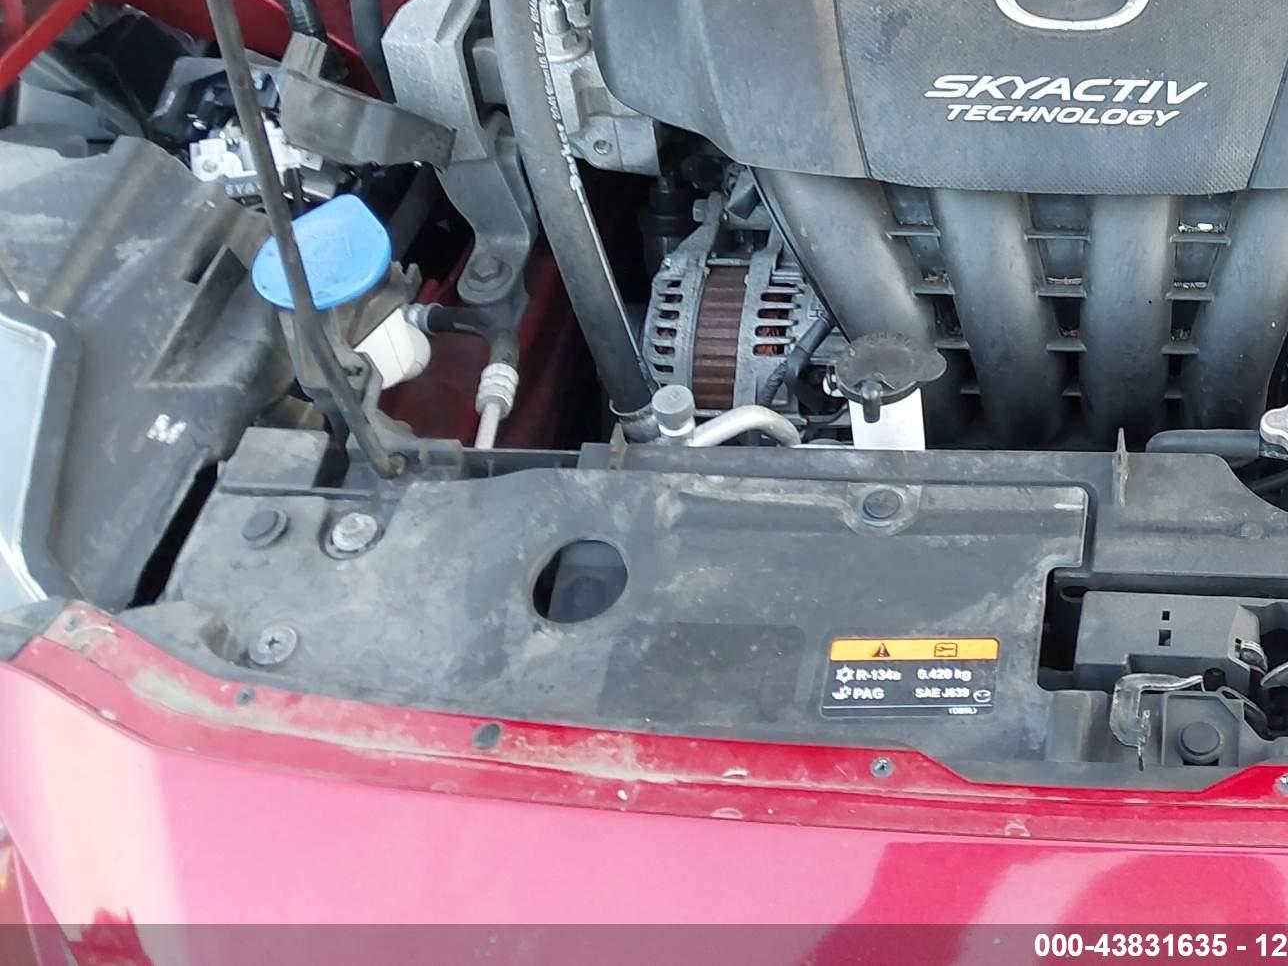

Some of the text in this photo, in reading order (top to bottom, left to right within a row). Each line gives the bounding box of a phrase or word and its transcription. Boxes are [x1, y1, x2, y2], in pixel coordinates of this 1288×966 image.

[924, 74, 1208, 105] SKYACTIV
[946, 104, 1181, 127] TECHNOLOGY
[954, 668, 972, 682] kg
[852, 687, 885, 700] PAG
[914, 687, 941, 699] SAE
